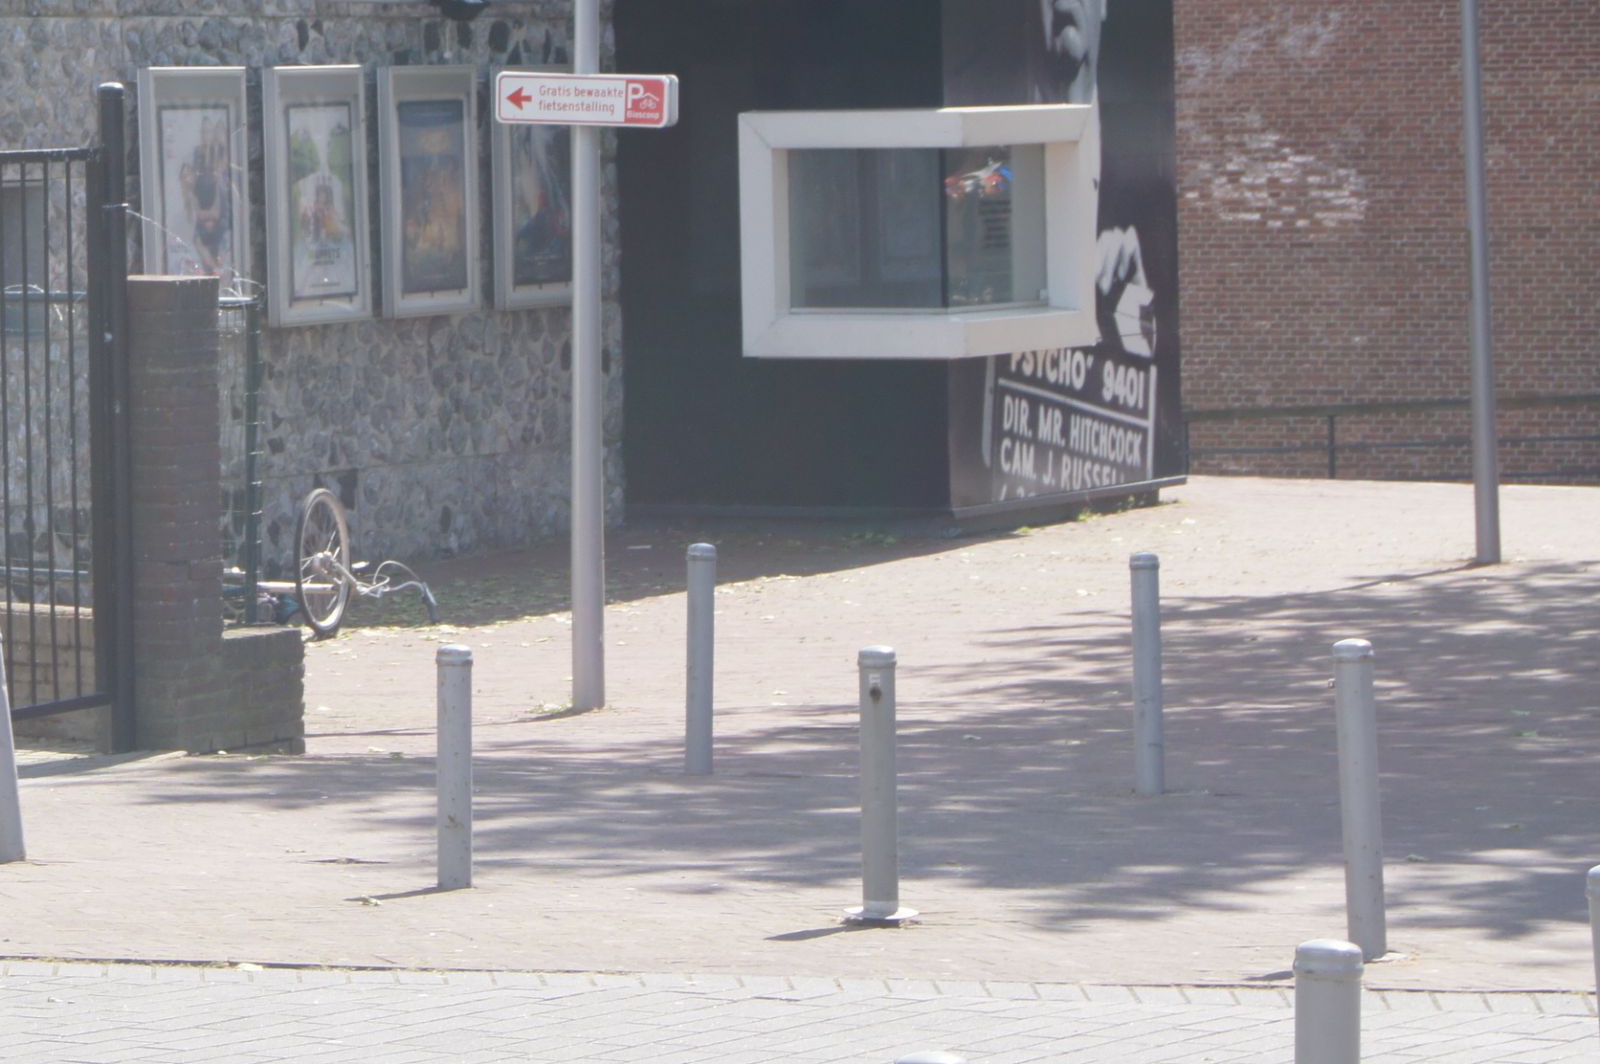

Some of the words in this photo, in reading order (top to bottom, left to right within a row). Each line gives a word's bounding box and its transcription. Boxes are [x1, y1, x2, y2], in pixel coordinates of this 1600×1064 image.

[538, 85, 572, 97] Gratis
[574, 86, 624, 98] bewaakte
[538, 100, 615, 116] fietsenstalling
[627, 83, 644, 109] P
[1102, 359, 1145, 410] 9401
[1002, 394, 1033, 438] DIR.
[1038, 403, 1066, 448] MR.
[1070, 413, 1143, 467] HITCHCOCK
[1000, 437, 1037, 481] CAM.
[1042, 449, 1056, 486] J.
[1060, 453, 1125, 491] RUSSE
